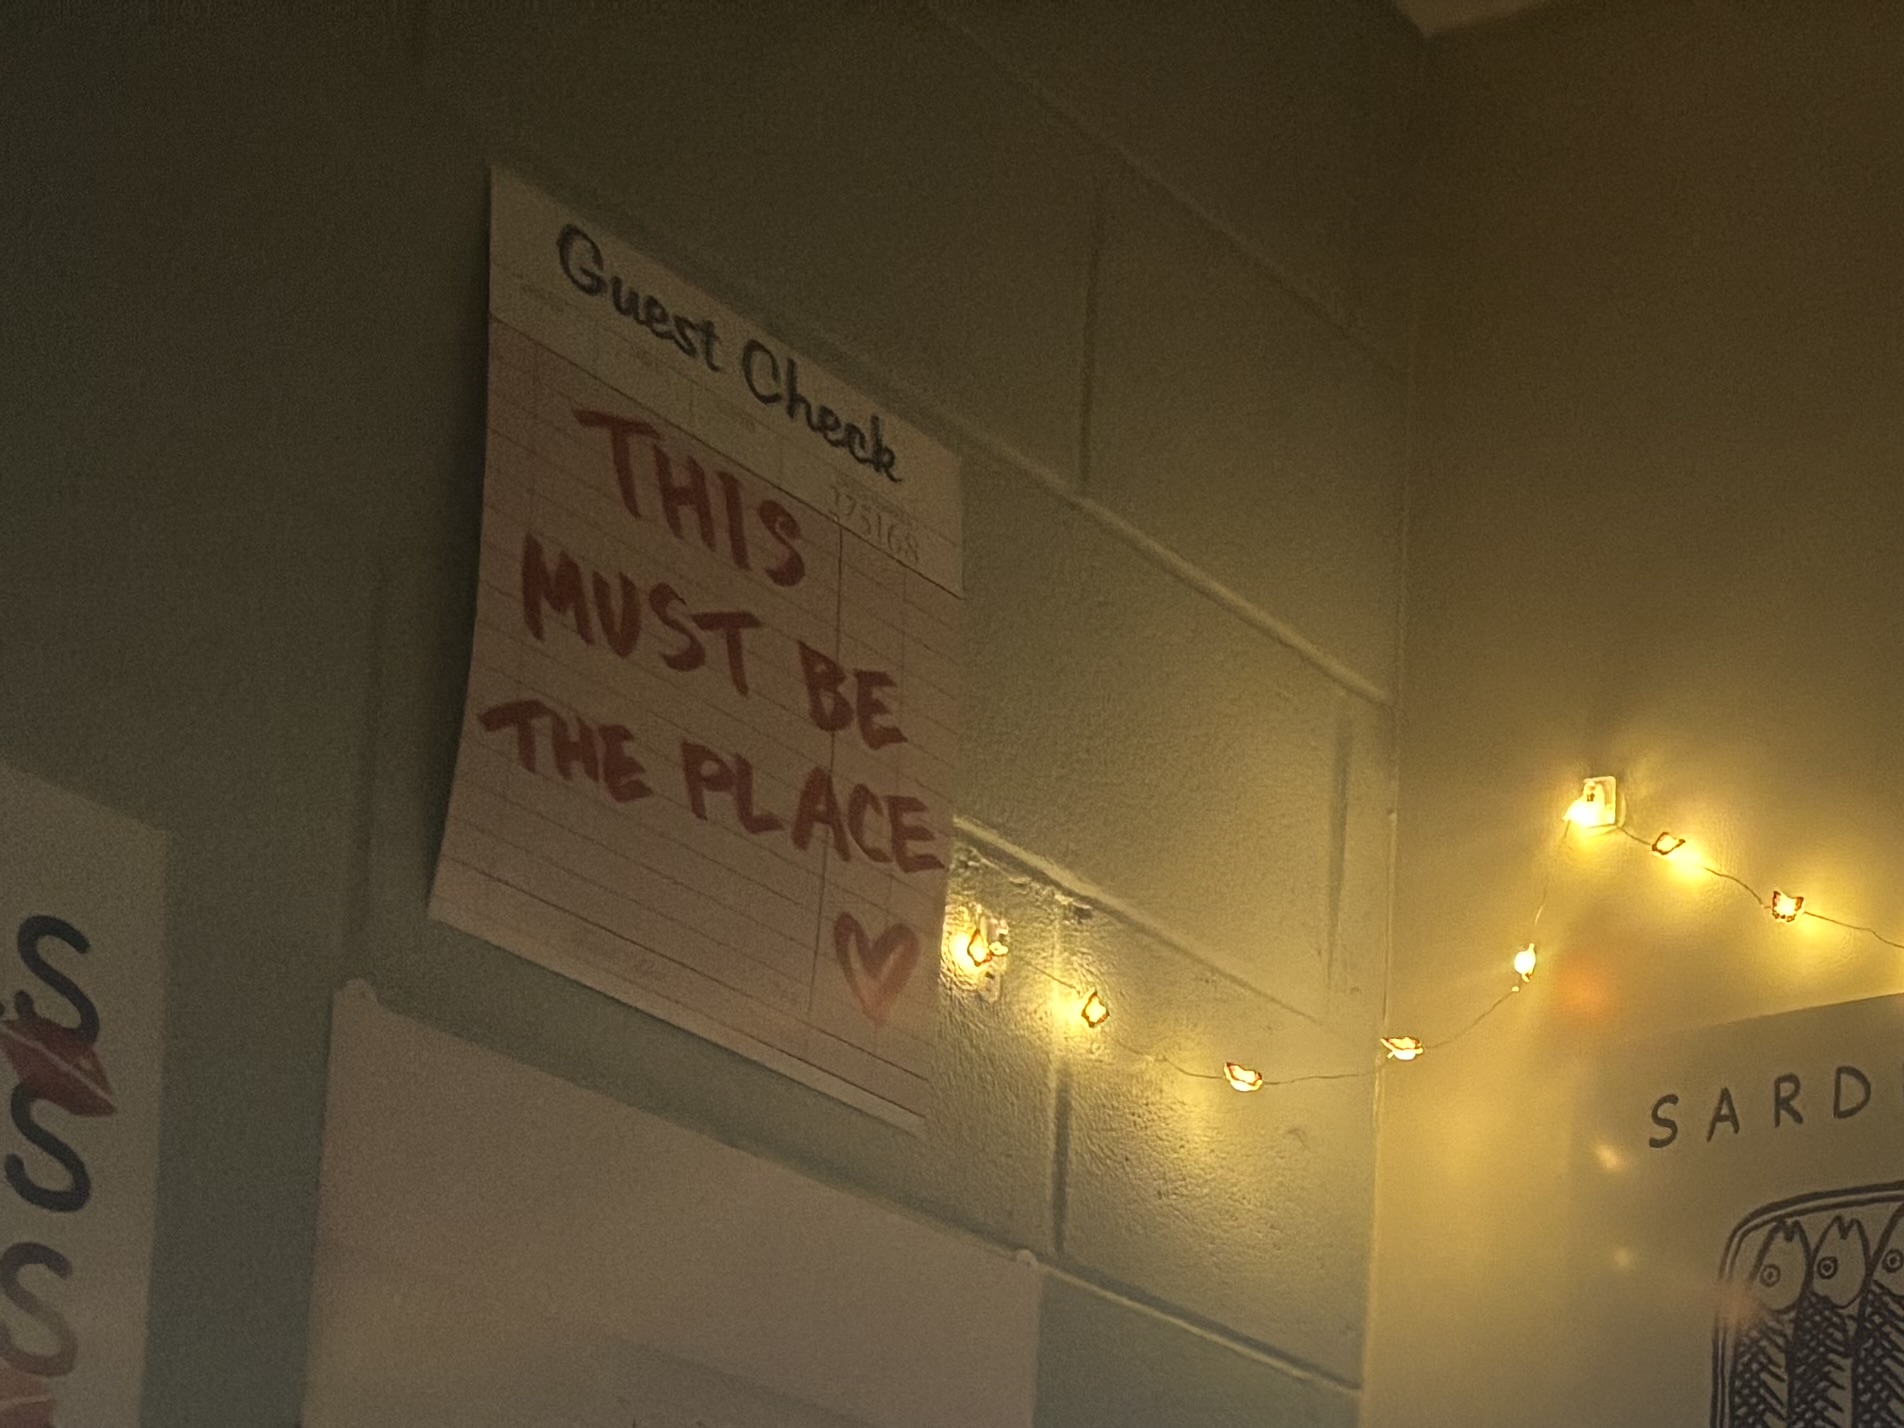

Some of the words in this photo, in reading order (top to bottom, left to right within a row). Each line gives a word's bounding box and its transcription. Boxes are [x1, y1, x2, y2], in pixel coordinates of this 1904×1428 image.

[557, 224, 721, 372] Guest
[740, 338, 903, 484] Check
[571, 407, 807, 588] THIS
[521, 530, 765, 698] MUST
[797, 639, 908, 751] BE
[478, 699, 656, 804] THE
[679, 735, 948, 875] PLACE
